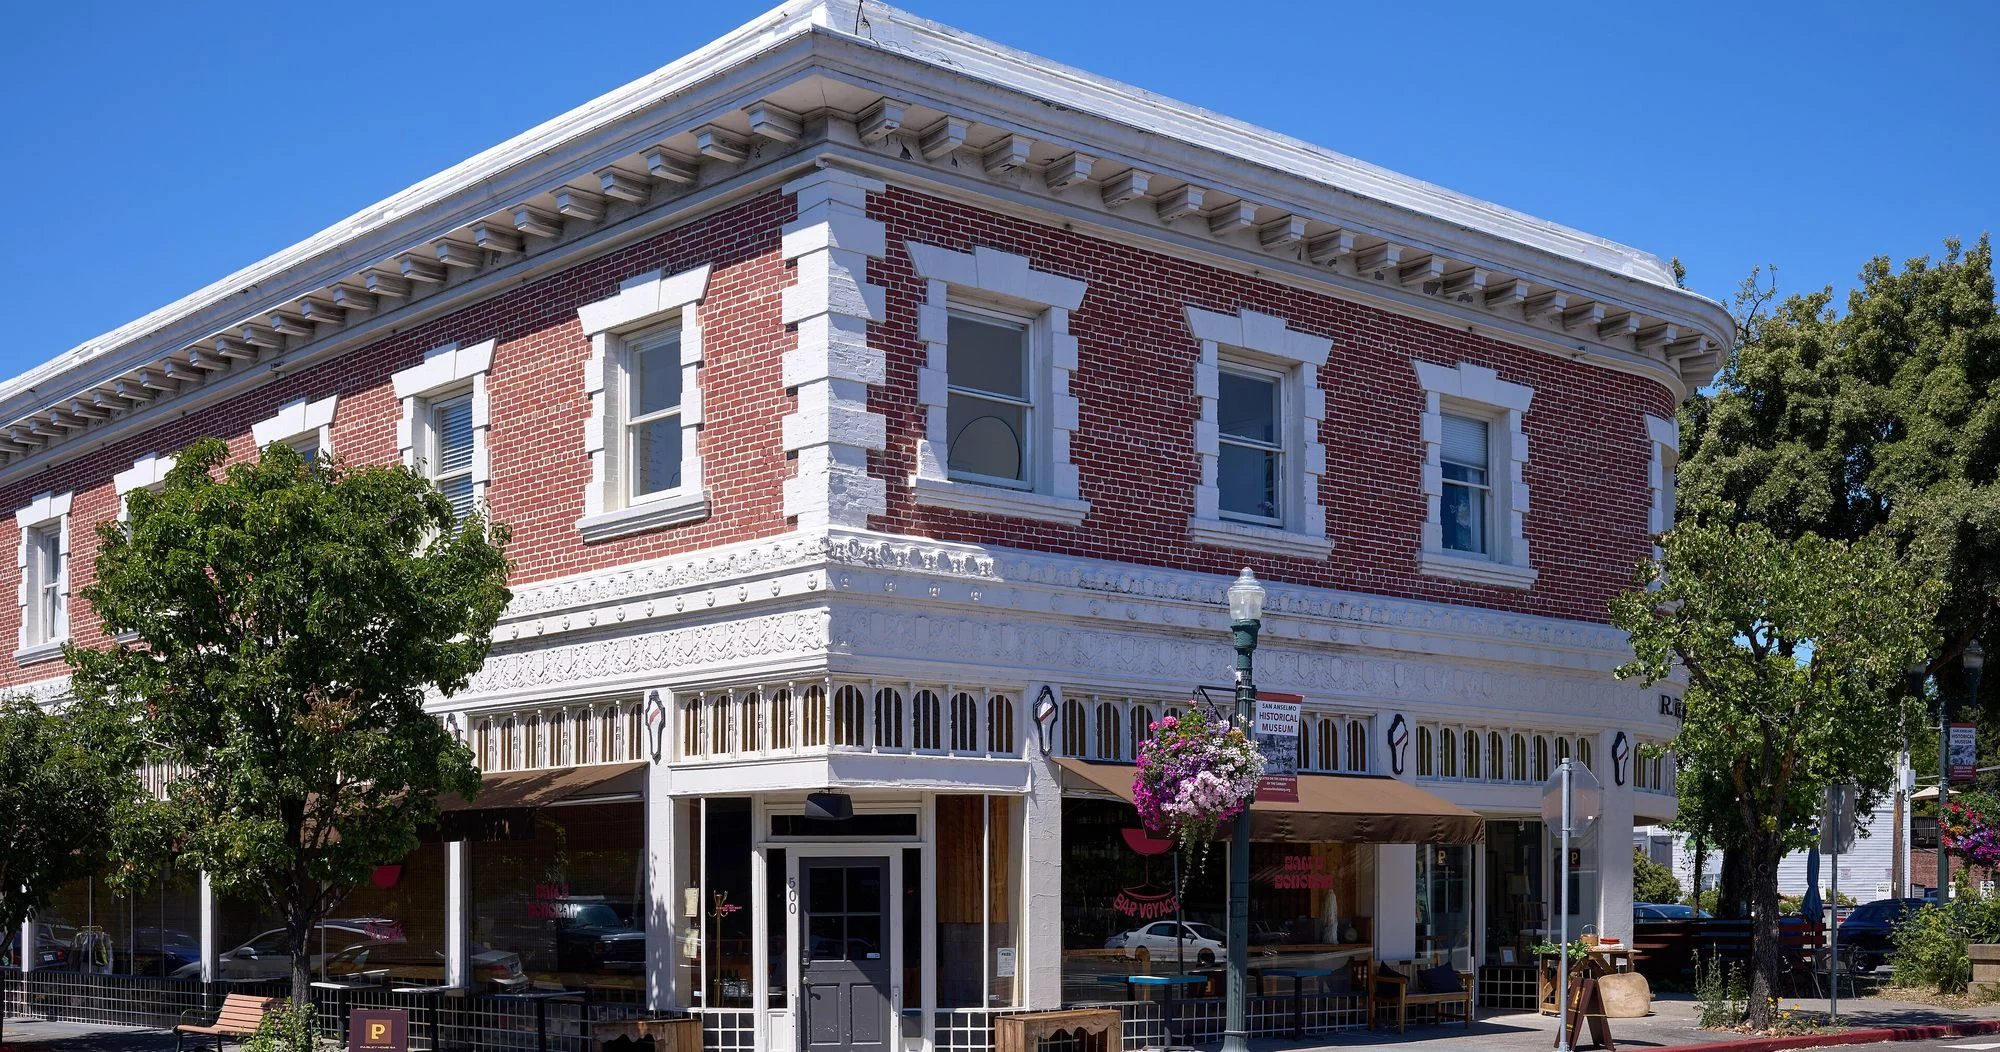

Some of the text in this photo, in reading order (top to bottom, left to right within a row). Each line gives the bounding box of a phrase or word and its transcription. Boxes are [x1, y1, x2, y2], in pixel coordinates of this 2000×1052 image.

[1259, 712, 1298, 722] HISTORICAL
[1262, 723, 1294, 733] MUSEUM
[1114, 893, 1180, 919] BAR VOYAGE
[372, 1024, 385, 1039] P
